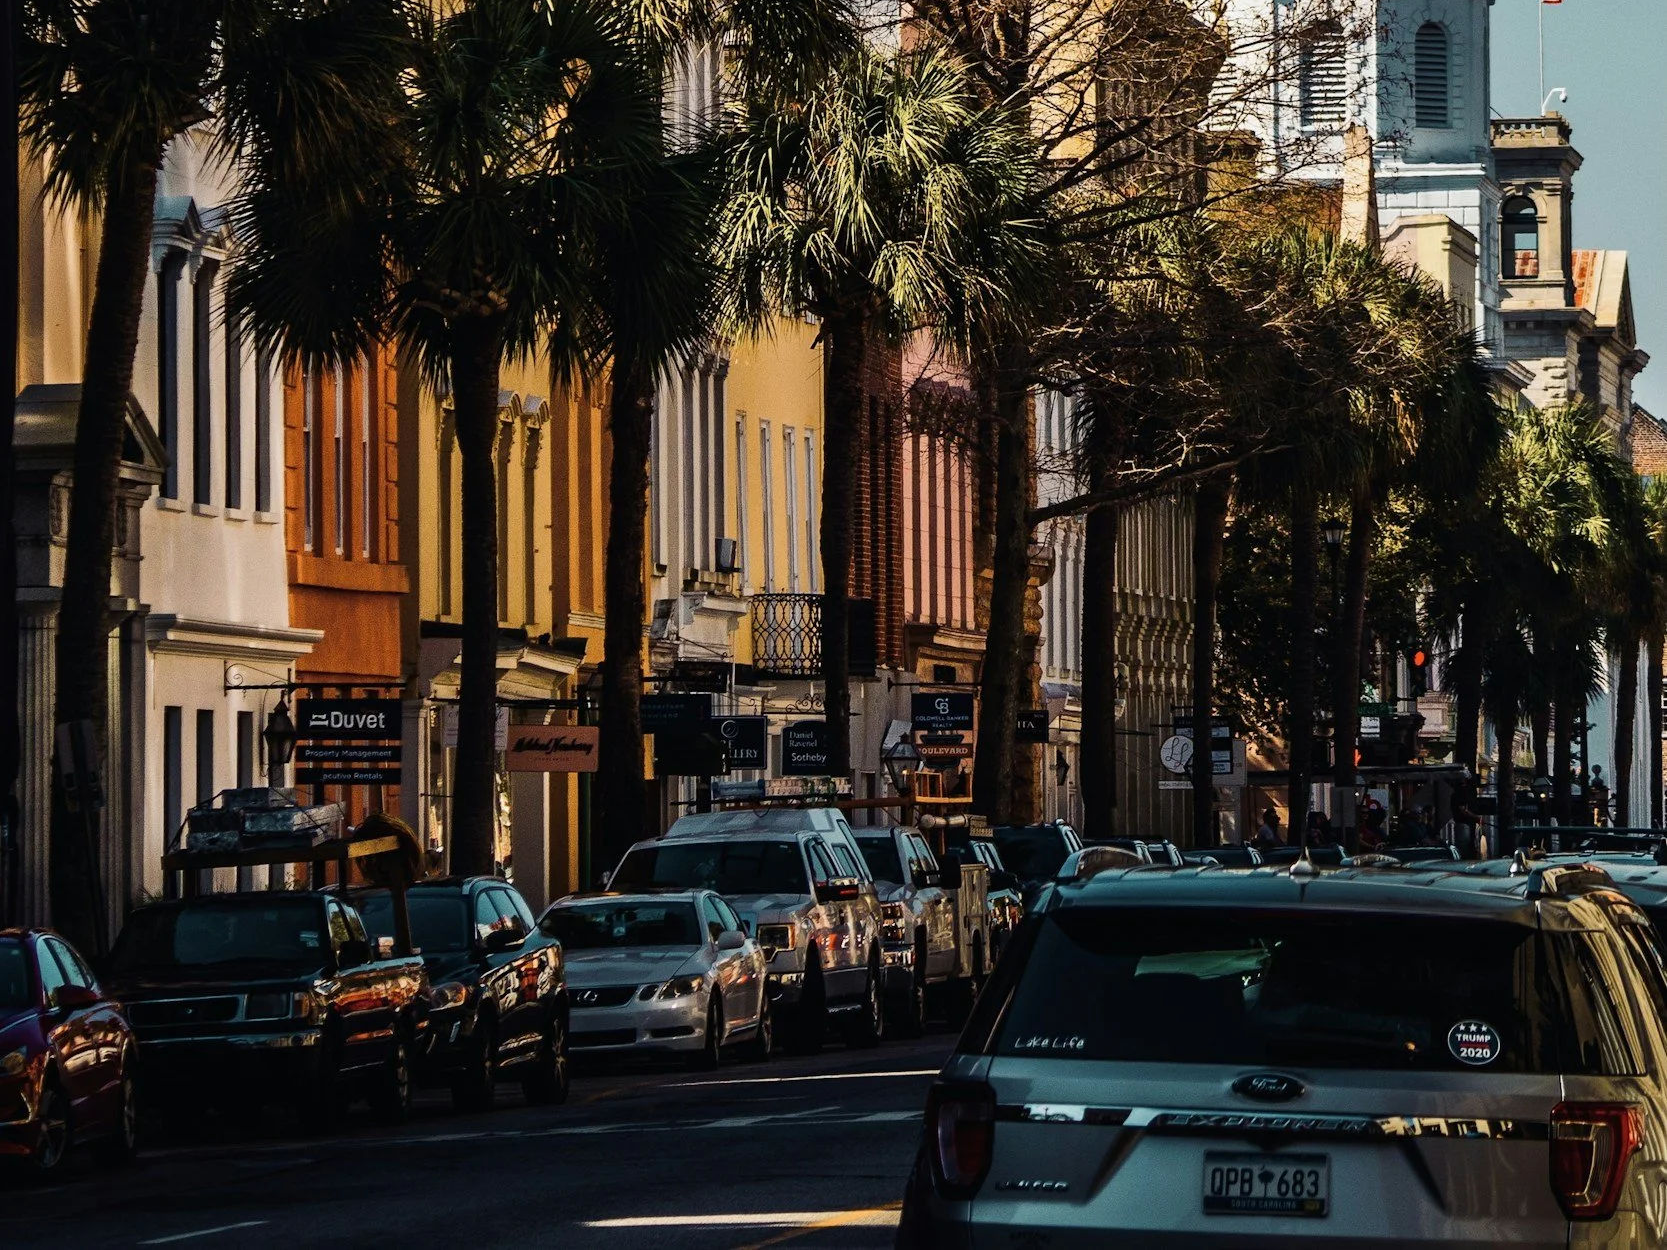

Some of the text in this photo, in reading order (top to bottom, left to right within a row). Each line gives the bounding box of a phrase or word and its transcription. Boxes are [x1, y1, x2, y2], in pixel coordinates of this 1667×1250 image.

[330, 711, 386, 729] Duvet
[789, 731, 813, 739] Daniel
[788, 739, 818, 748] Ravenel
[305, 749, 392, 759] Property Management
[353, 772, 383, 780] Rentals
[1014, 1035, 1085, 1050] Lake Life
[1455, 1033, 1491, 1043] TRUMP
[1460, 1047, 1491, 1058] 2020
[1248, 1077, 1288, 1093] Ford
[1277, 1169, 1320, 1197] 683
[1230, 1198, 1256, 1210] SOUTH
[1258, 1198, 1297, 1211] CAROLINA
